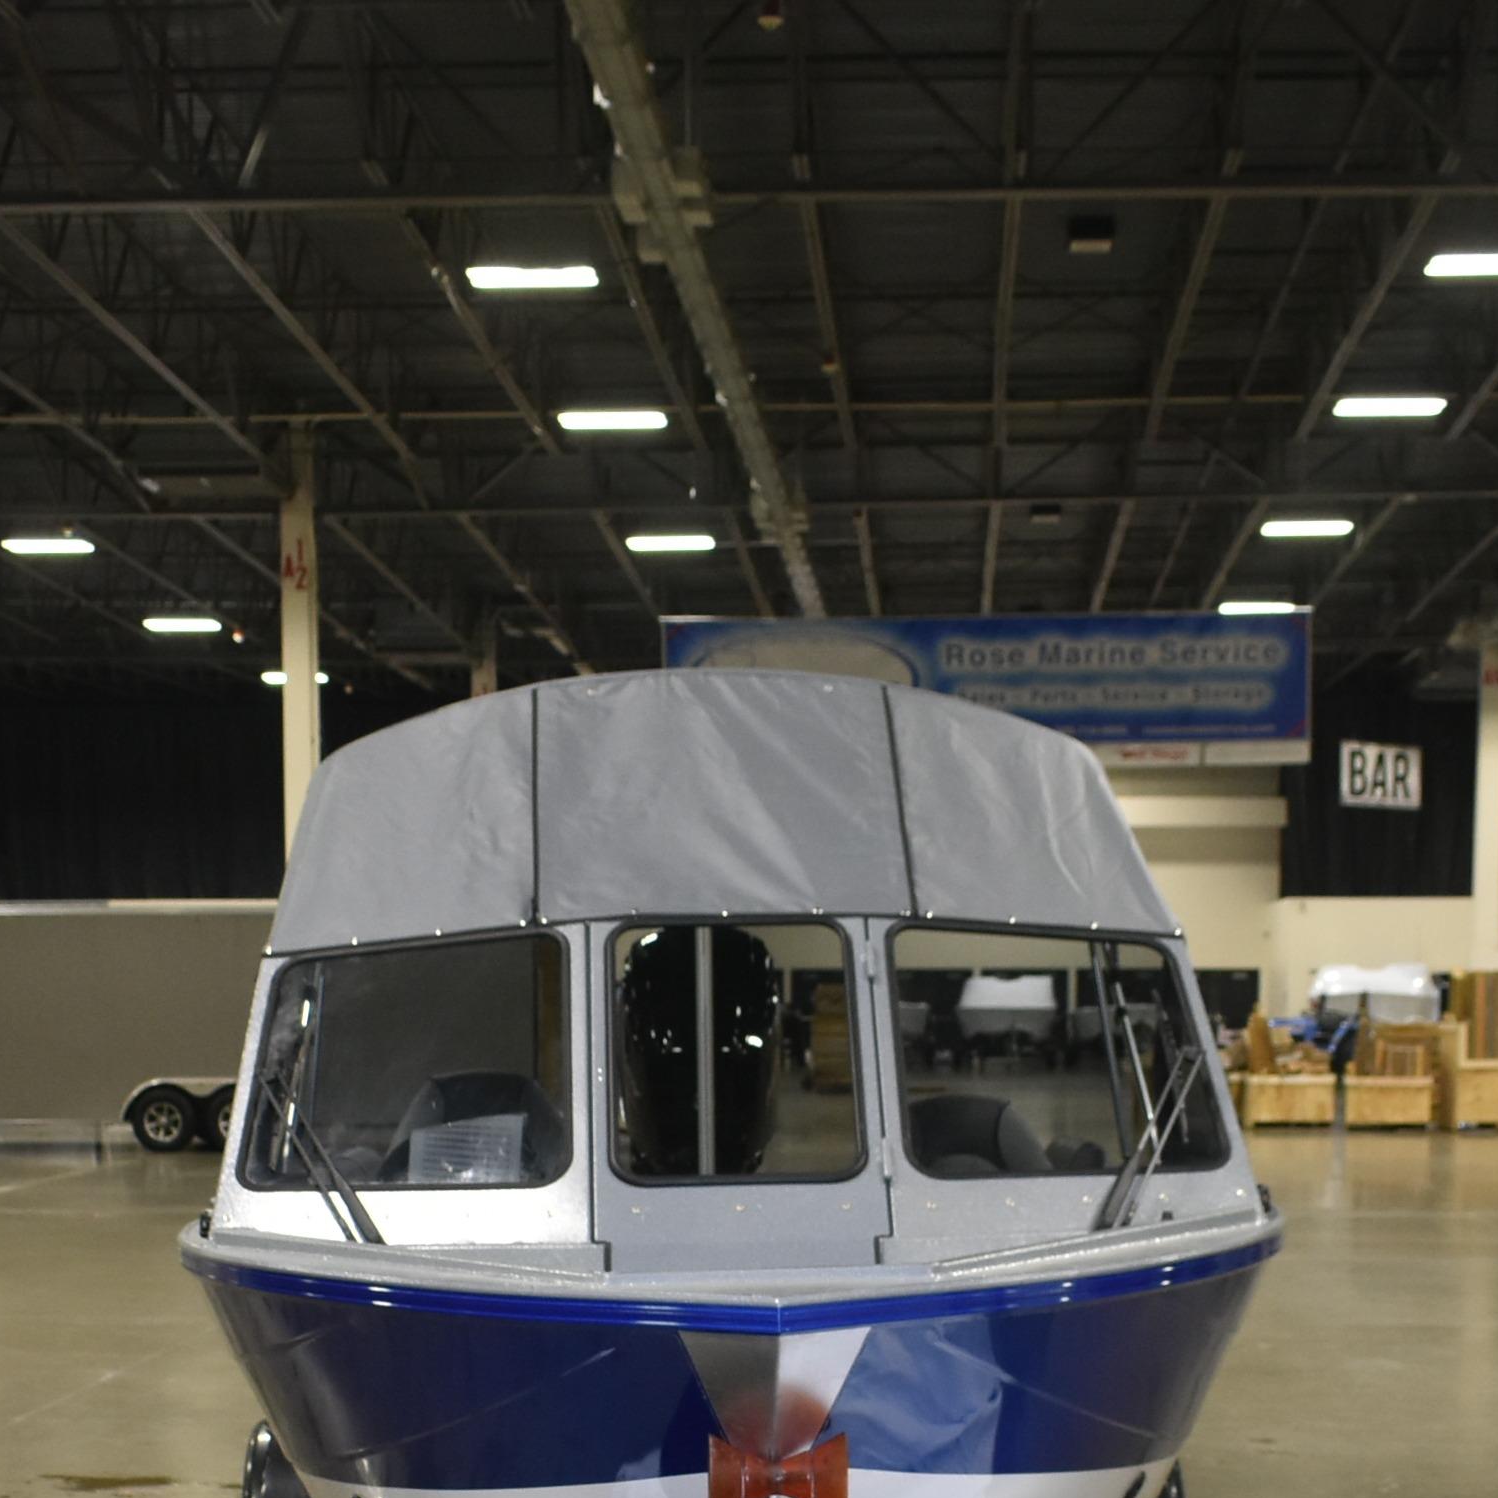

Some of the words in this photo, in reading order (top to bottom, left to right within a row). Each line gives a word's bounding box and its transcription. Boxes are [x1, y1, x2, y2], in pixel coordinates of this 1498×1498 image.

[944, 643, 1025, 667] Rose
[1037, 641, 1146, 665] Marine
[1158, 639, 1279, 664] Service
[1350, 750, 1410, 799] BAR
